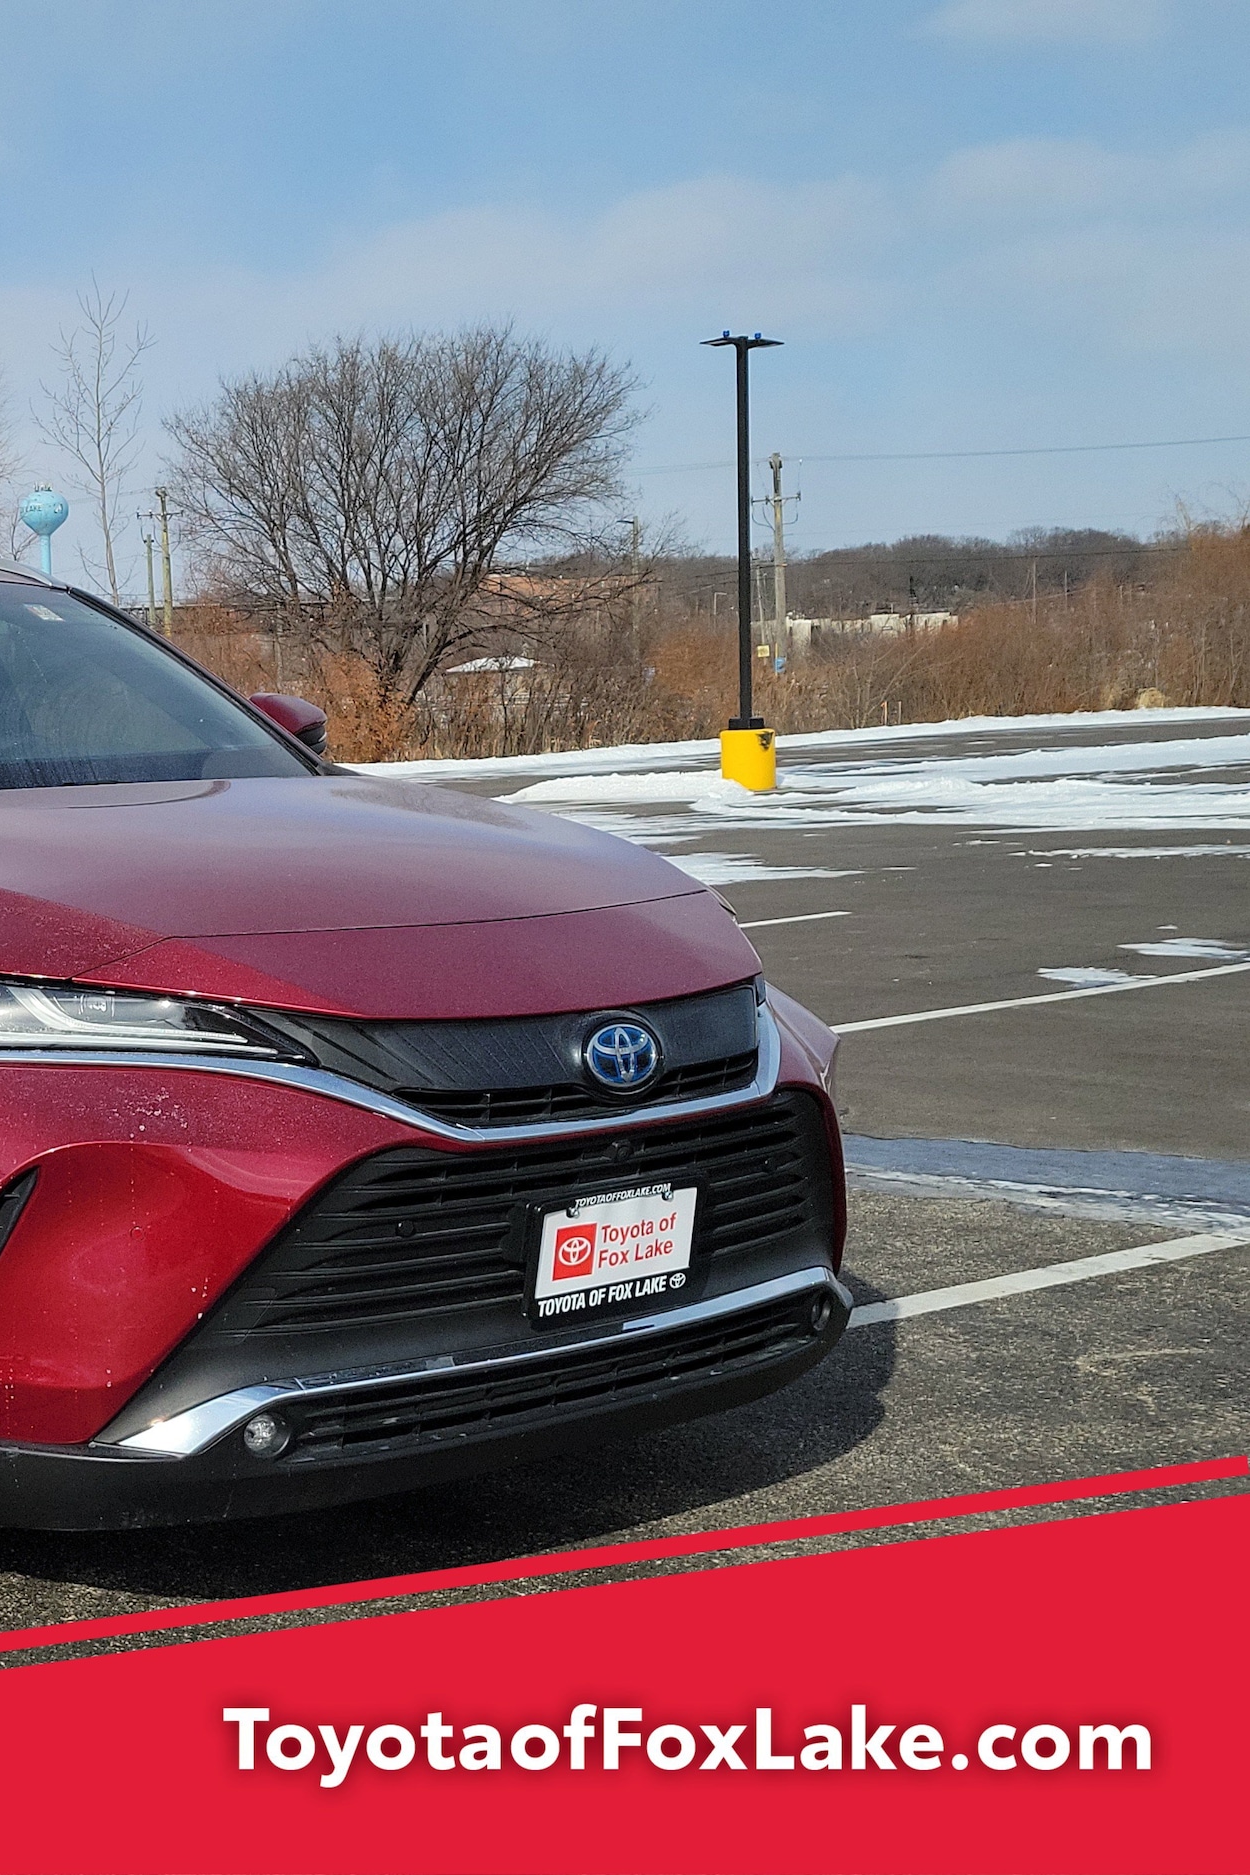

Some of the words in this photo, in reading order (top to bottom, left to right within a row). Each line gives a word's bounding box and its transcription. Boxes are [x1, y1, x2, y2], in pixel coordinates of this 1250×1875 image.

[574, 1183, 671, 1208] TOYOTAOFFOXLAKE.COM
[601, 1219, 654, 1246] Toyota
[659, 1212, 677, 1231] of
[598, 1250, 630, 1269] Fox
[634, 1238, 673, 1261] Lake
[538, 1292, 586, 1317] TOYOTA
[589, 1287, 607, 1307] OF
[608, 1283, 632, 1304] FOX
[635, 1275, 667, 1298] LAKE
